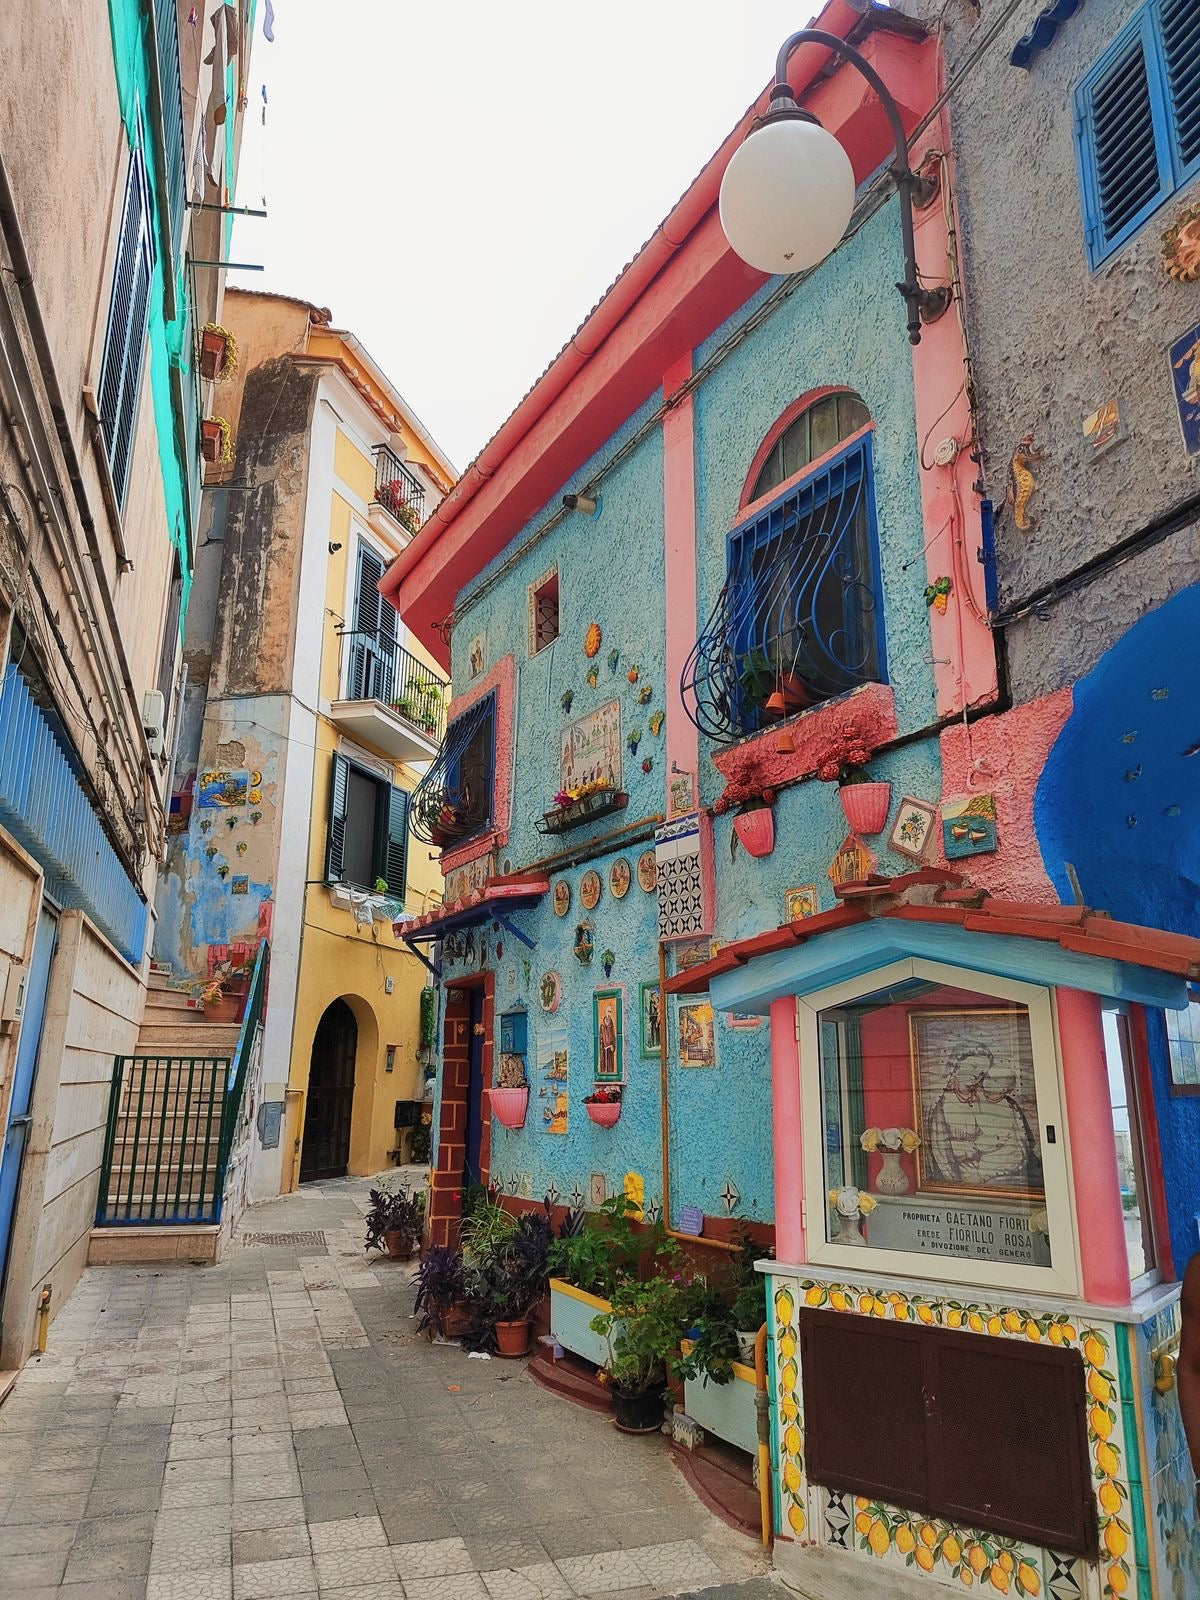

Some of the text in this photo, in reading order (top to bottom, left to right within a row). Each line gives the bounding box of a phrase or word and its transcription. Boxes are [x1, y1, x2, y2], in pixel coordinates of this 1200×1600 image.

[946, 1211, 992, 1228] GAETANO
[917, 1227, 1032, 1249] EREDE FIORILLO ROSA
[931, 1242, 969, 1252] DIVOZIONE
[976, 1246, 991, 1255] DEL
[999, 1249, 1031, 1258] GENERO
